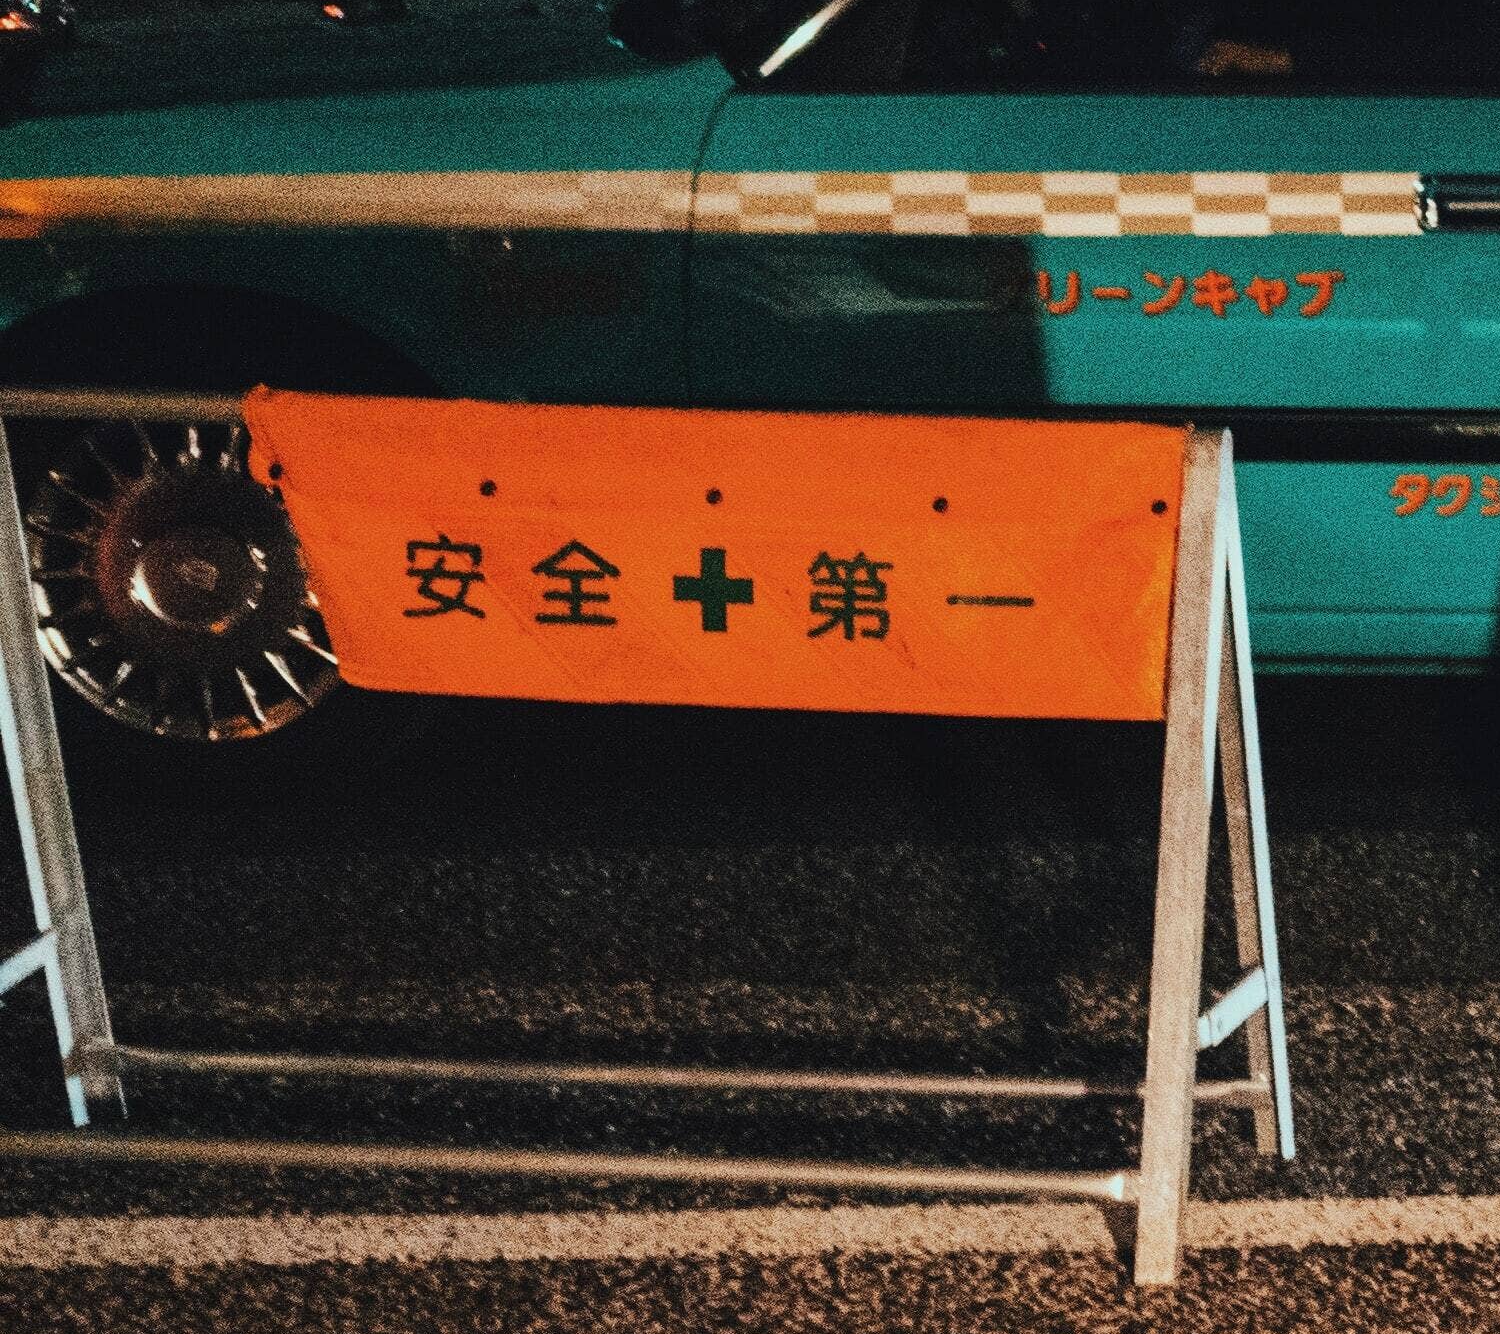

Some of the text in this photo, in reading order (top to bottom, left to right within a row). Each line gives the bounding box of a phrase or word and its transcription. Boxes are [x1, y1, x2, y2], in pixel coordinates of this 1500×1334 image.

[1035, 269, 1346, 318] リーンキャブ
